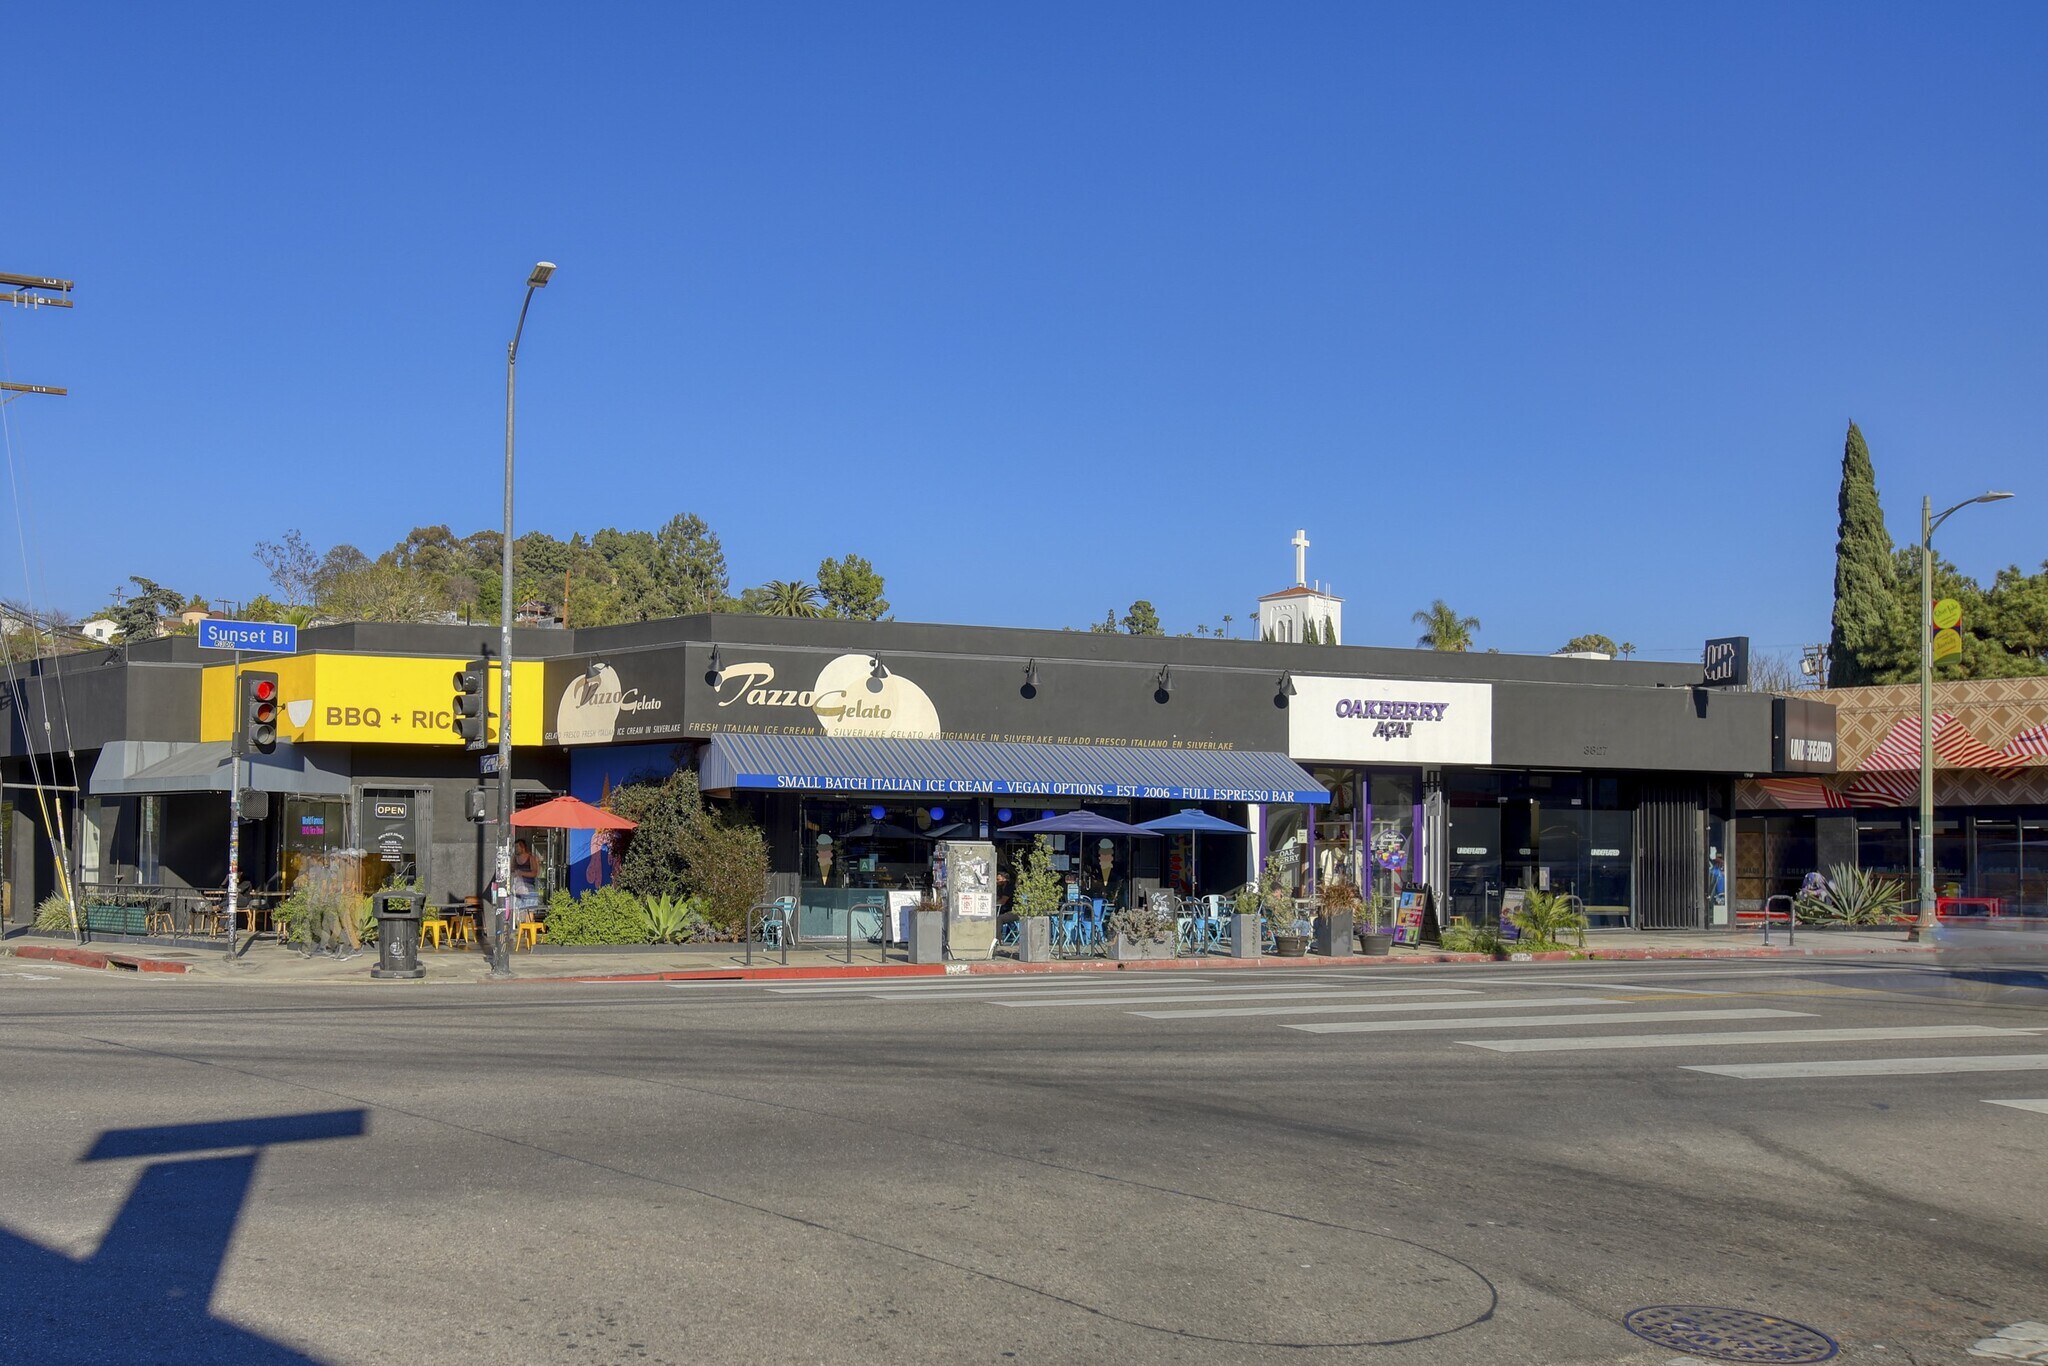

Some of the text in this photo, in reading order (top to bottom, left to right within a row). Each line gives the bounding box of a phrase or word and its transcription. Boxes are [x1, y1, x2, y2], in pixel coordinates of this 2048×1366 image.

[208, 625, 289, 645] Sunset Bl
[573, 674, 622, 709] Pazzo
[714, 662, 815, 707] Pazzo
[620, 688, 662, 715] Gelato
[812, 690, 892, 722] Gelato
[1335, 698, 1450, 721] OAKBERRY
[326, 707, 381, 728] BBQ
[616, 727, 625, 736] ICE
[627, 726, 644, 735] CREAM
[645, 725, 651, 734] IN
[653, 723, 681, 733] SILVERLAKE
[688, 722, 1234, 750] FRESH ITALIAN ICE CREAM IN SILVERLAKE GELATO ARTIGIANALE IN SILVERLAKE HELADO FRESCO ITALIANO EN SILVERLAKE
[777, 776, 821, 789] SMALL
[825, 777, 867, 790] BATCH
[870, 778, 921, 791] ITALIAN
[926, 780, 945, 791] ICE
[949, 780, 993, 793] CREAM
[1006, 782, 1050, 794] VEGAN
[1053, 783, 1104, 796] OPTIONS
[1116, 785, 1139, 797] EST.
[1143, 786, 1170, 799] 2006
[1182, 788, 1210, 800] FULL
[1213, 789, 1269, 802] ESPRESSO
[1272, 791, 1295, 803] BAR
[377, 806, 405, 815] OPEN
[1279, 848, 1295, 857] OAK
[1456, 847, 1488, 855] UNDEFEATED
[1590, 848, 1620, 856] UNDEFEATED
[861, 860, 869, 870] A
